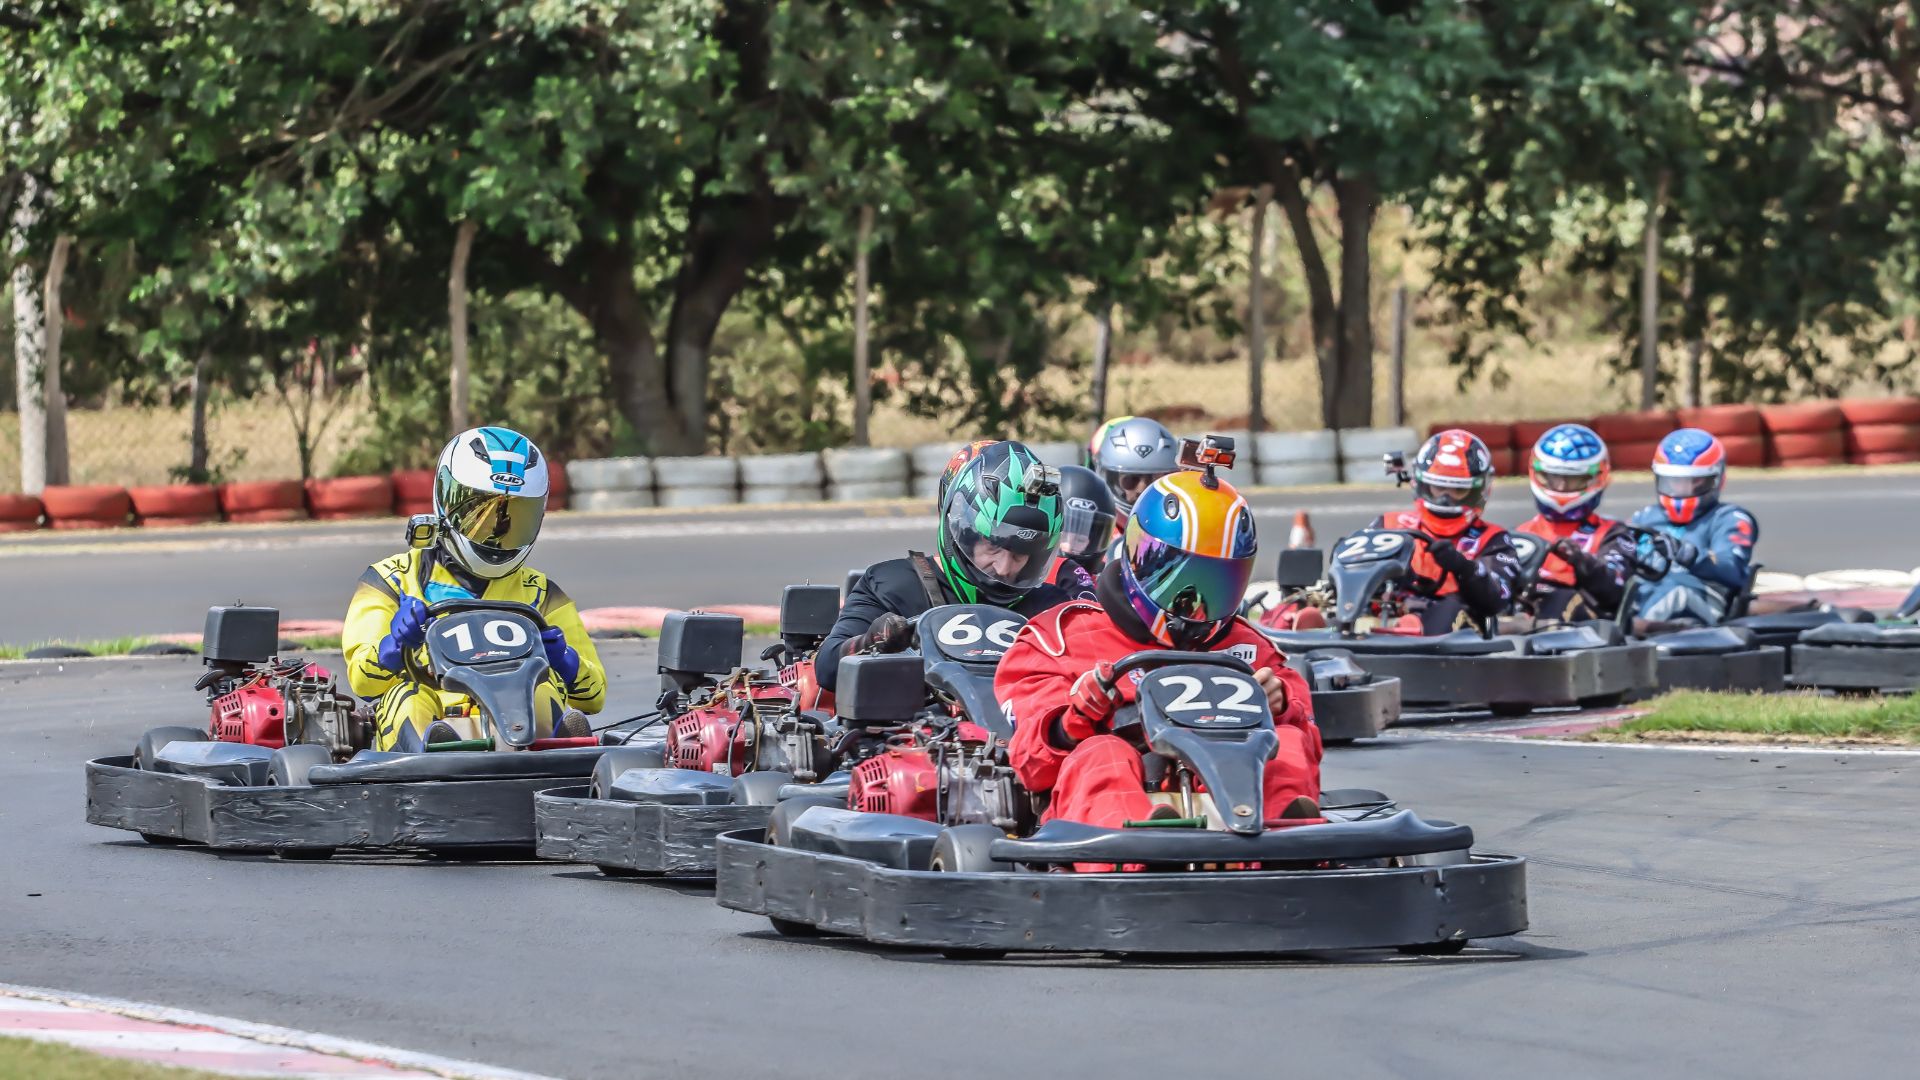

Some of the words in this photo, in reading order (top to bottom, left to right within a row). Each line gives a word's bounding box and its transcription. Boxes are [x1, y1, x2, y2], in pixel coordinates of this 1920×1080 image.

[494, 474, 520, 484] HJC
[1071, 498, 1093, 509] FLY
[1337, 533, 1404, 559] 29
[441, 620, 527, 652] 10
[938, 613, 1020, 648] 66
[1158, 675, 1262, 713] 22
